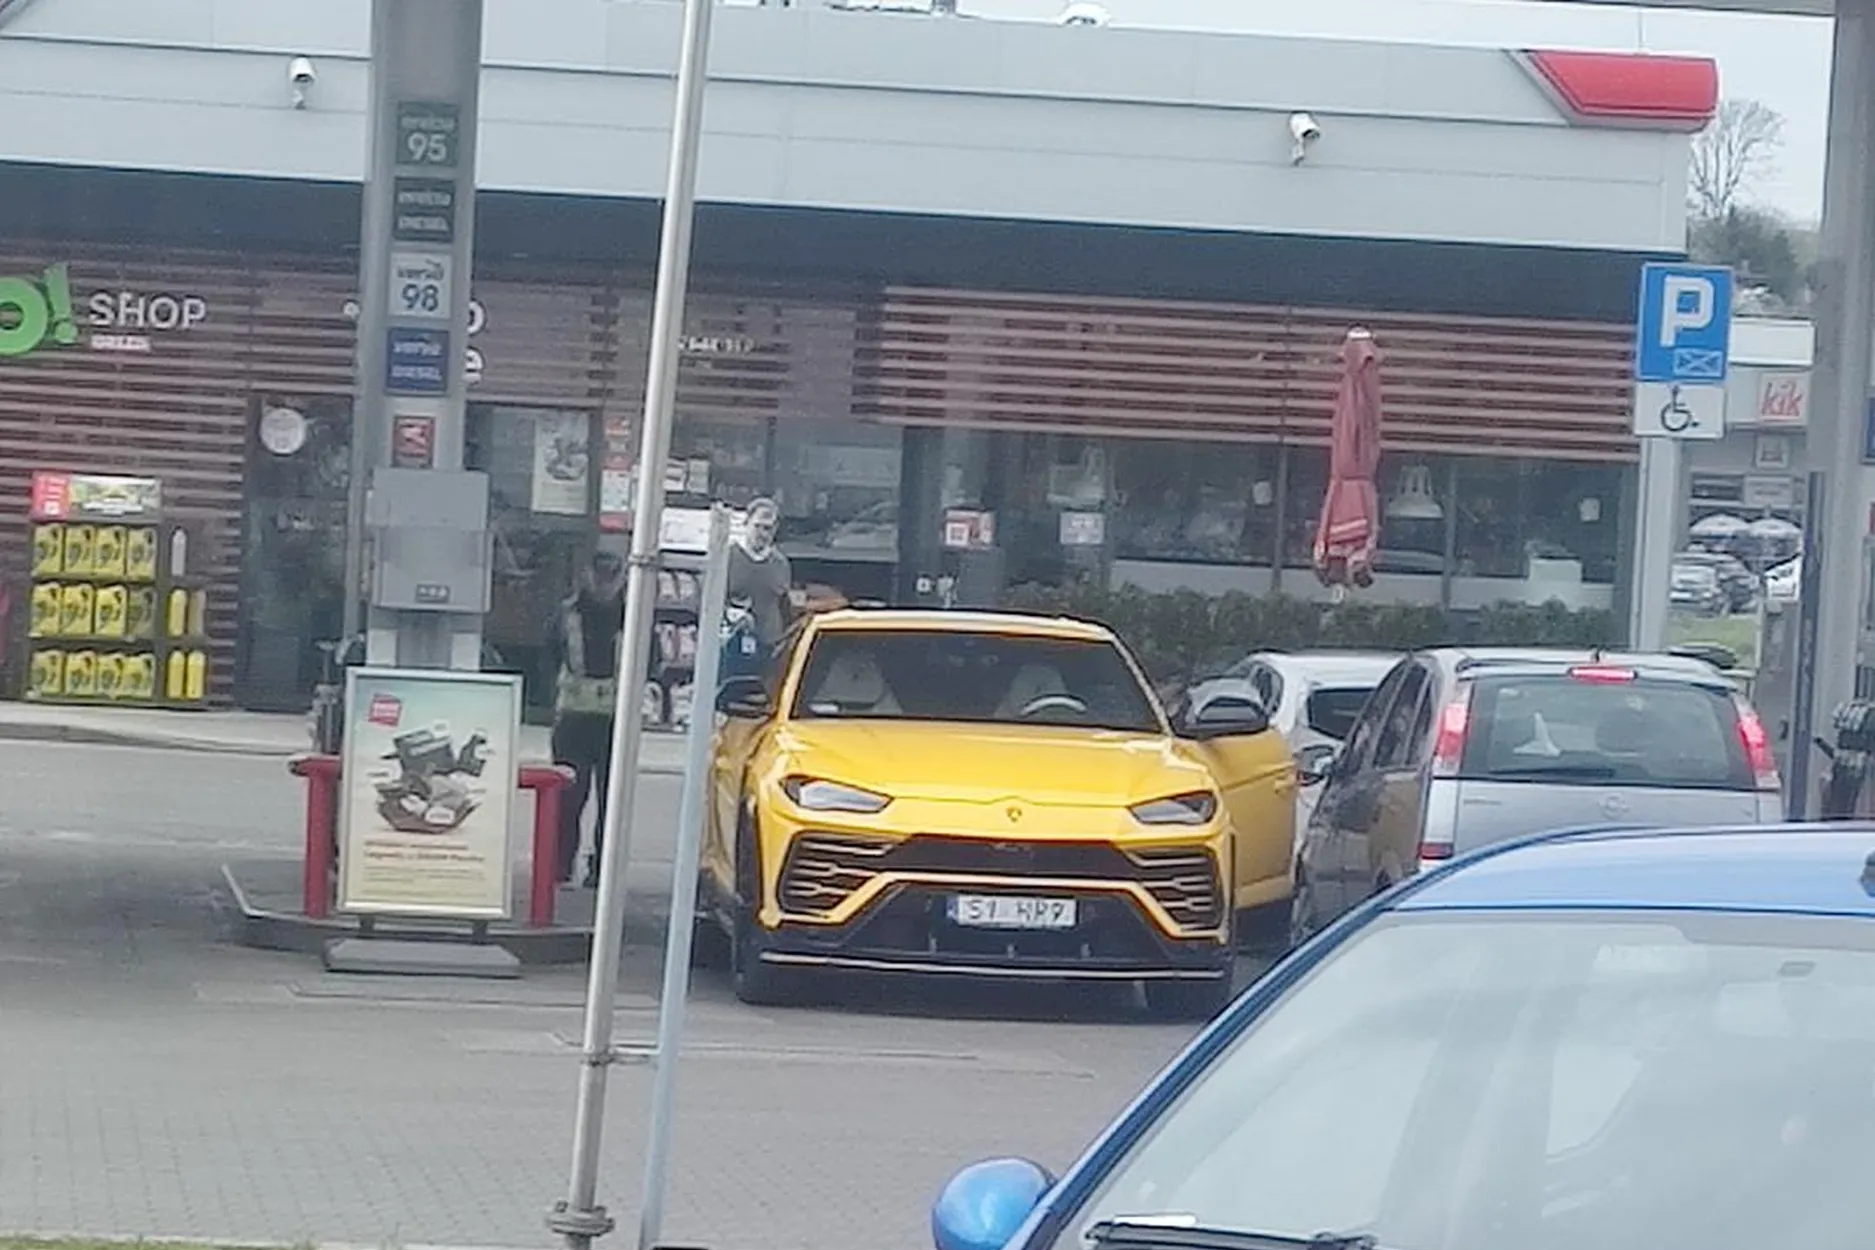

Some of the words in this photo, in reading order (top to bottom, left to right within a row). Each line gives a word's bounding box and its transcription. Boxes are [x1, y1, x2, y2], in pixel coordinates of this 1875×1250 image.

[406, 131, 448, 162] 95
[88, 291, 206, 330] SHOP
[402, 282, 440, 313] 98
[1660, 274, 1714, 348] P
